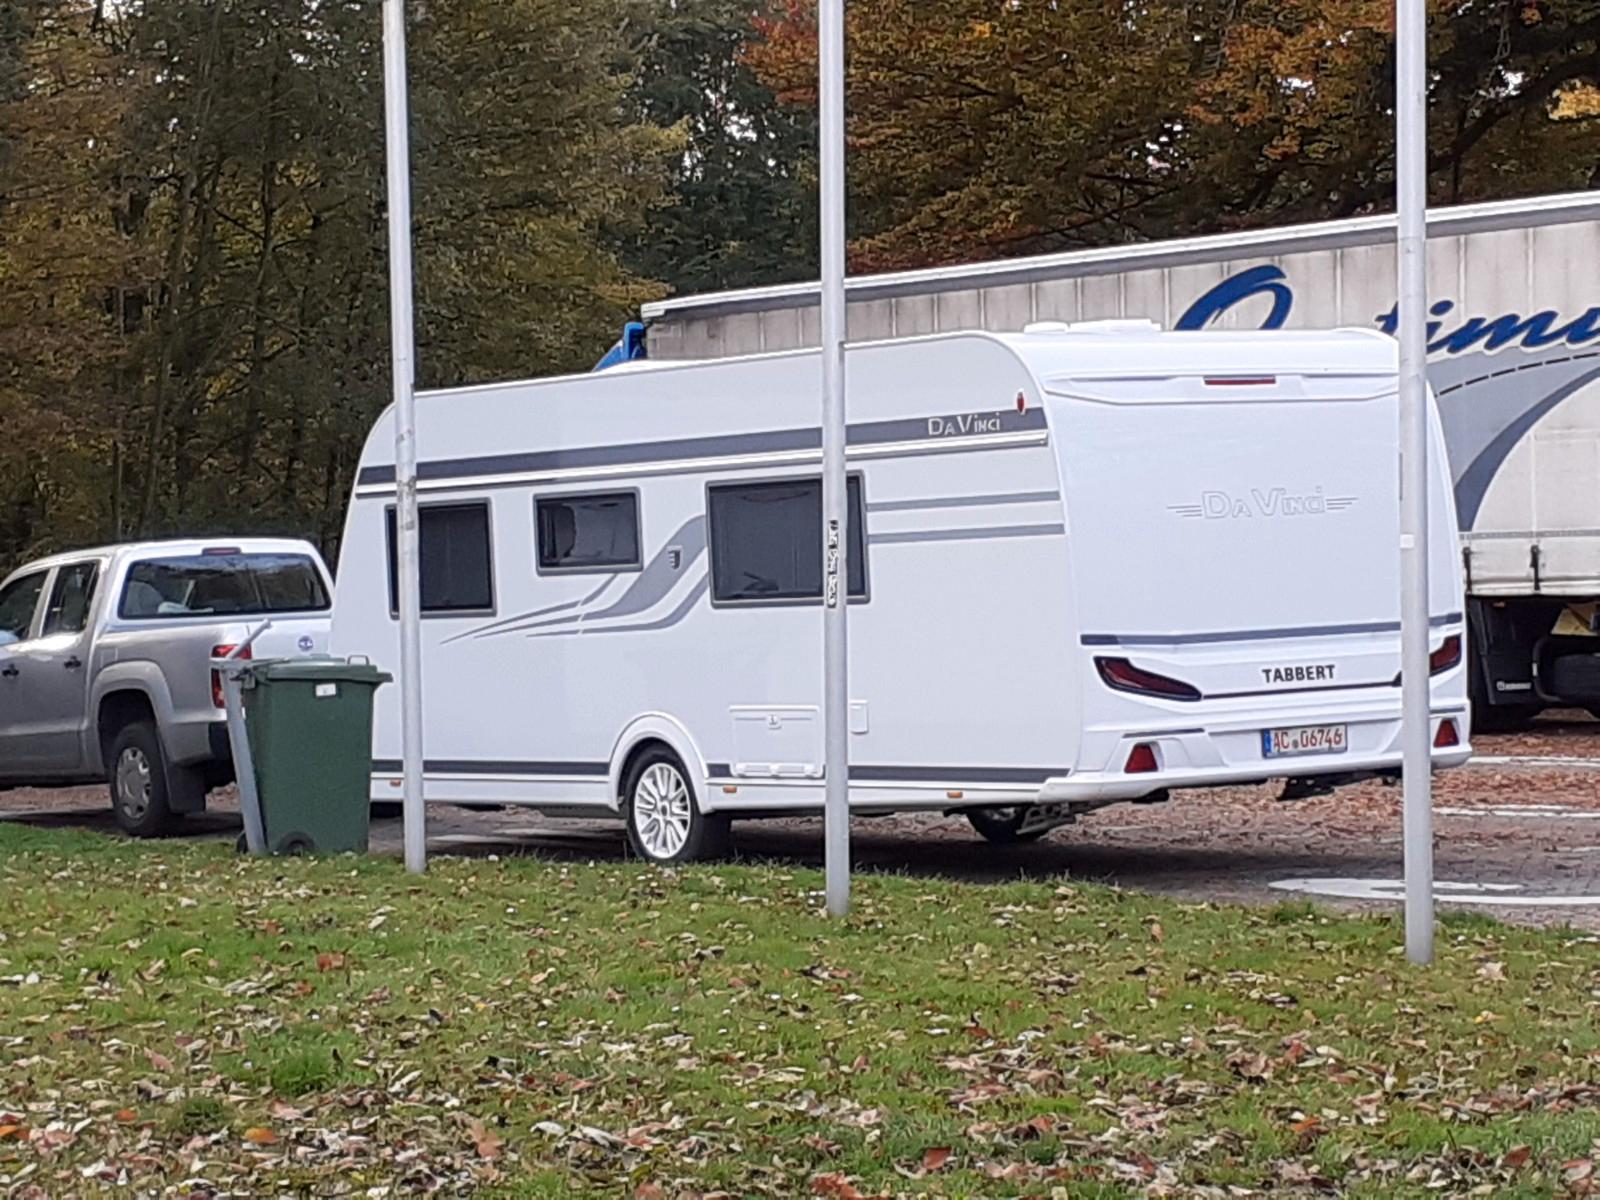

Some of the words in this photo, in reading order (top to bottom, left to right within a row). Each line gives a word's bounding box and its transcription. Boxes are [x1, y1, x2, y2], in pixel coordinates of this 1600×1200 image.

[1261, 664, 1335, 683] TABBERT
[1273, 730, 1290, 751] AC
[1300, 727, 1343, 749] 06746
